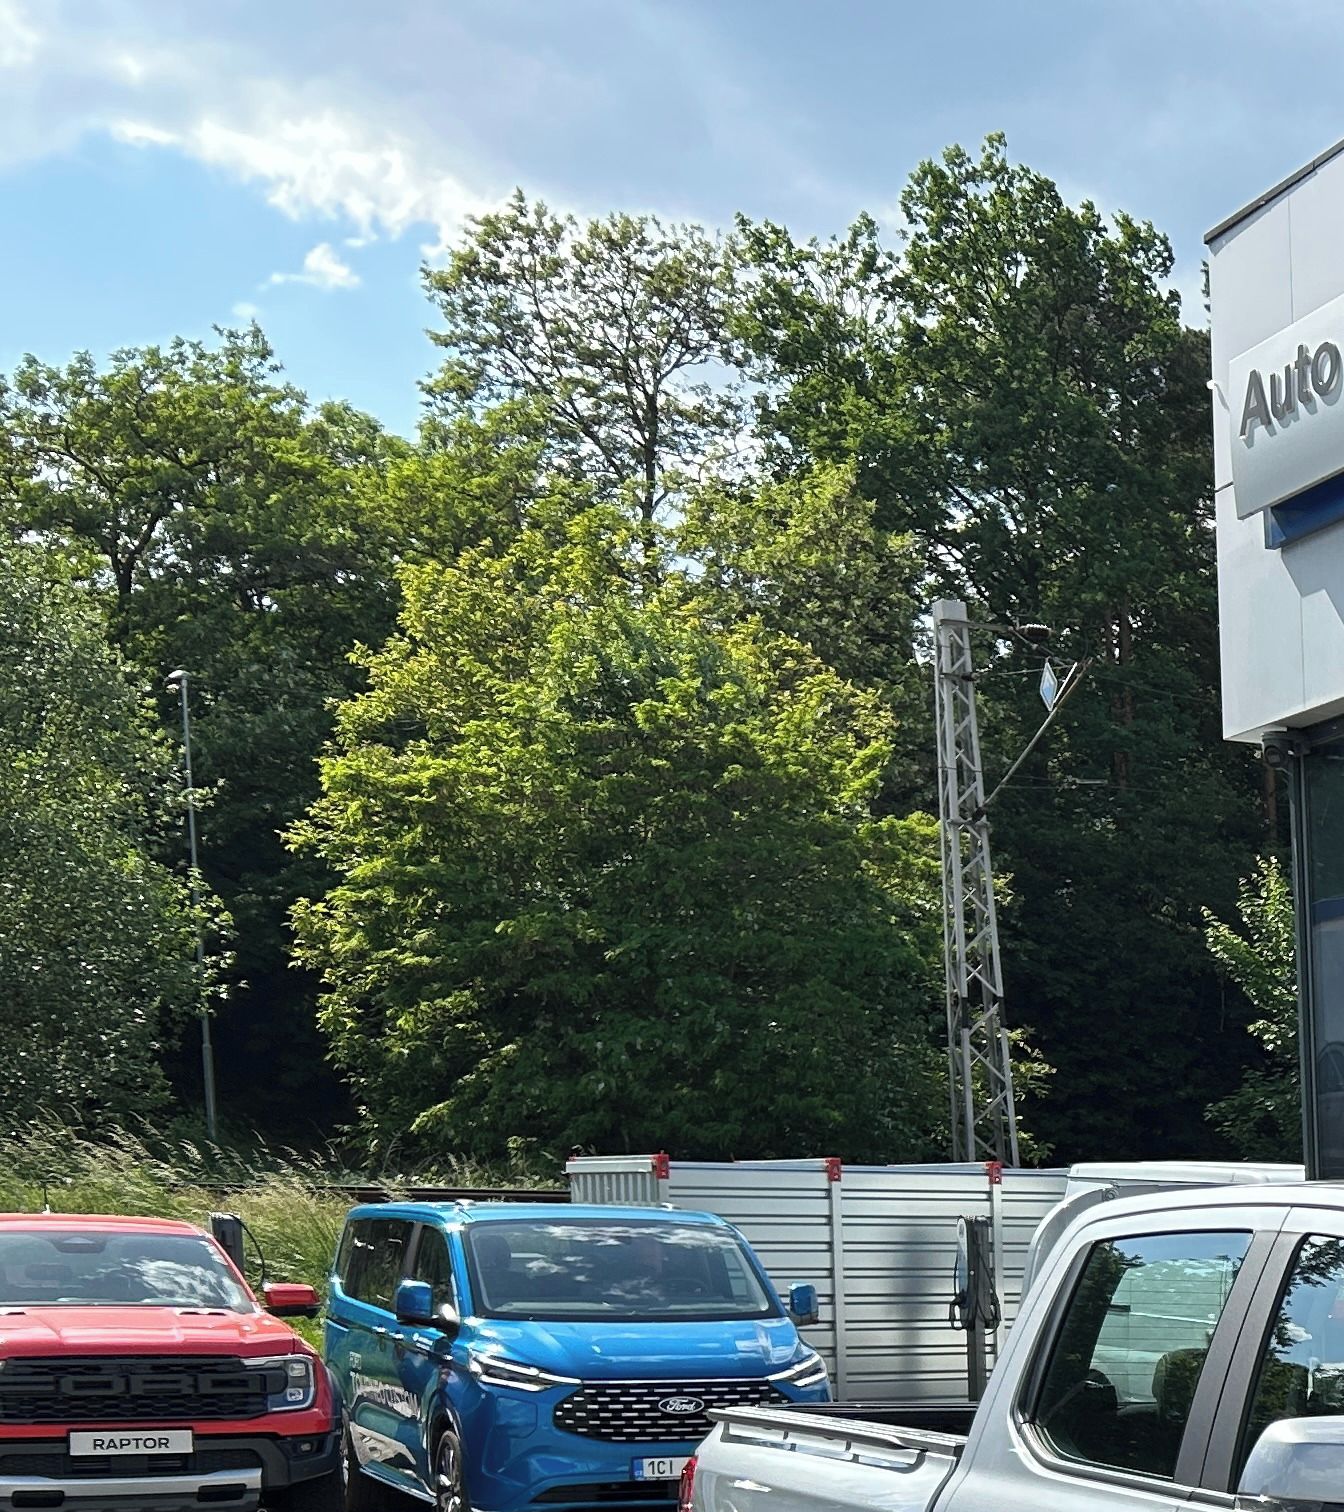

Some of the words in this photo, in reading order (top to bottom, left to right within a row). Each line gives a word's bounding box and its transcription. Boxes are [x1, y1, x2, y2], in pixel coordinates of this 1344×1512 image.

[1239, 341, 1342, 441] Auto
[666, 1398, 697, 1411] Ford
[92, 1437, 170, 1451] RAPTOR
